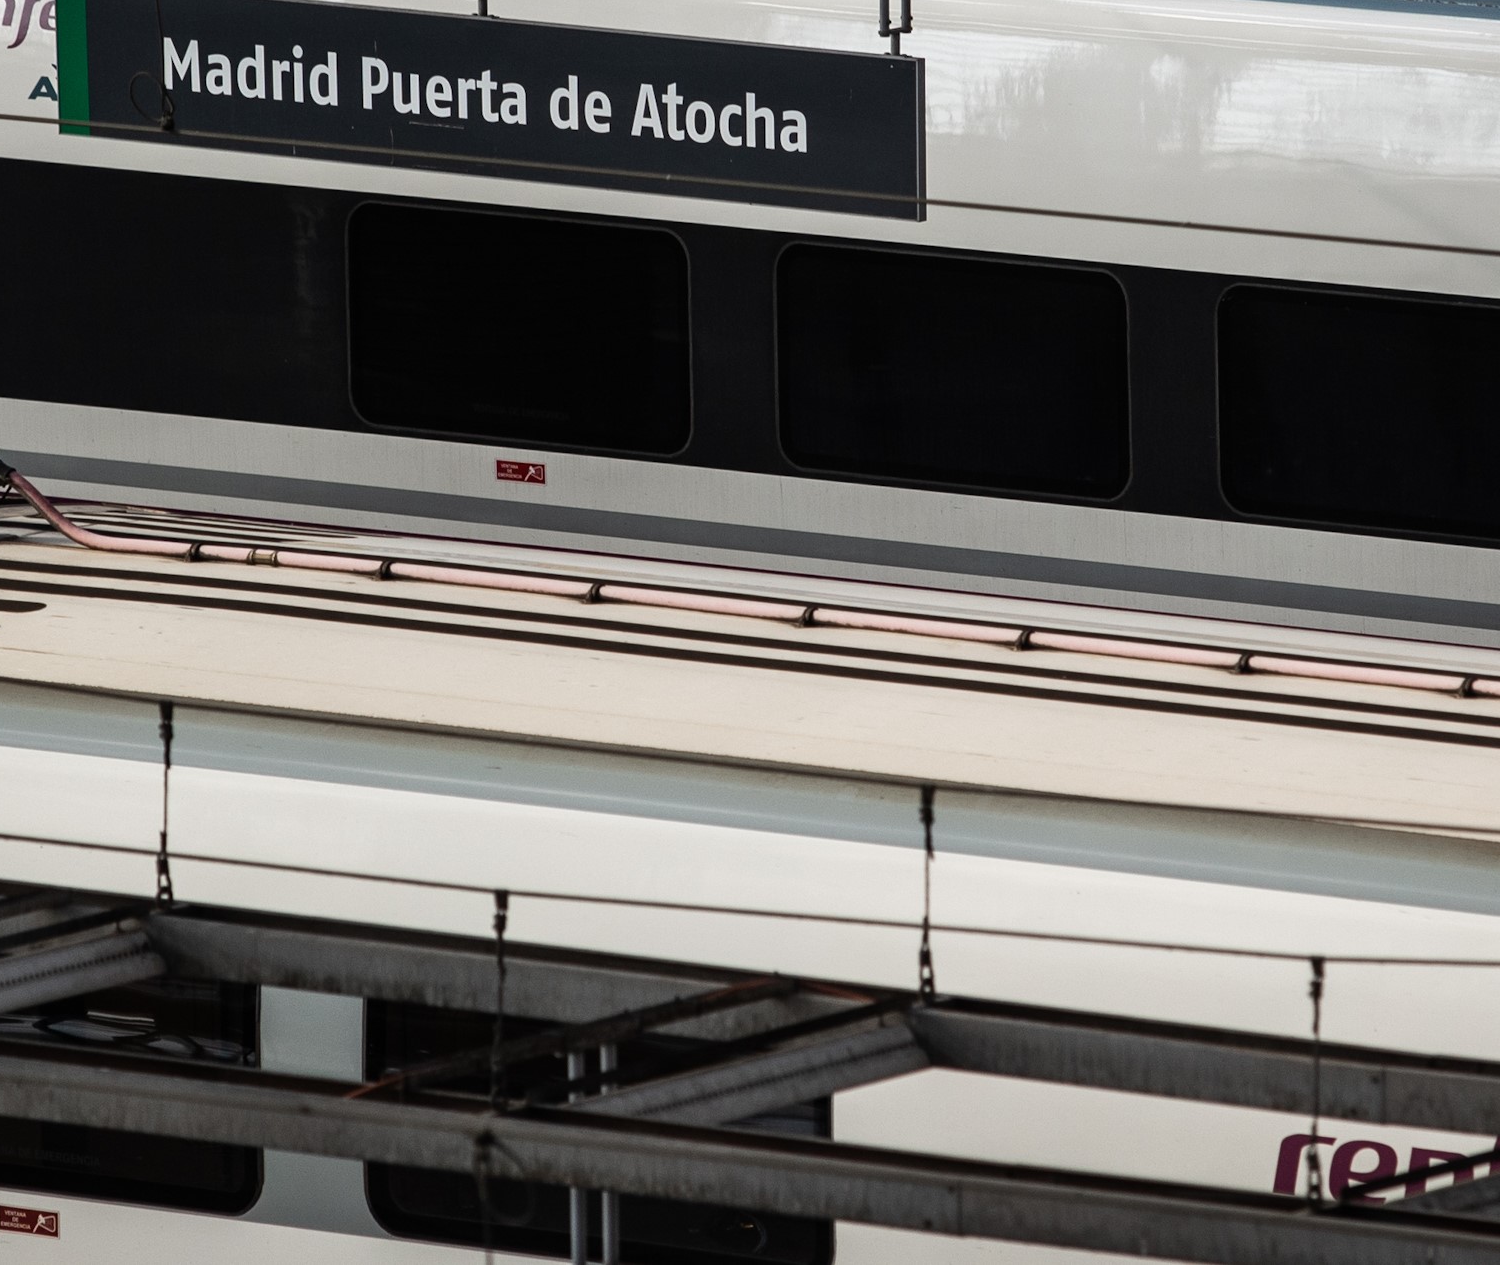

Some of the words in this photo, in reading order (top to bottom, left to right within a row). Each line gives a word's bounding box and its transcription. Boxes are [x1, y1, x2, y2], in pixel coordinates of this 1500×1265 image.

[163, 37, 338, 106] Madrid
[361, 55, 528, 125] Puerta
[549, 75, 612, 133] de
[631, 80, 808, 153] Atocha
